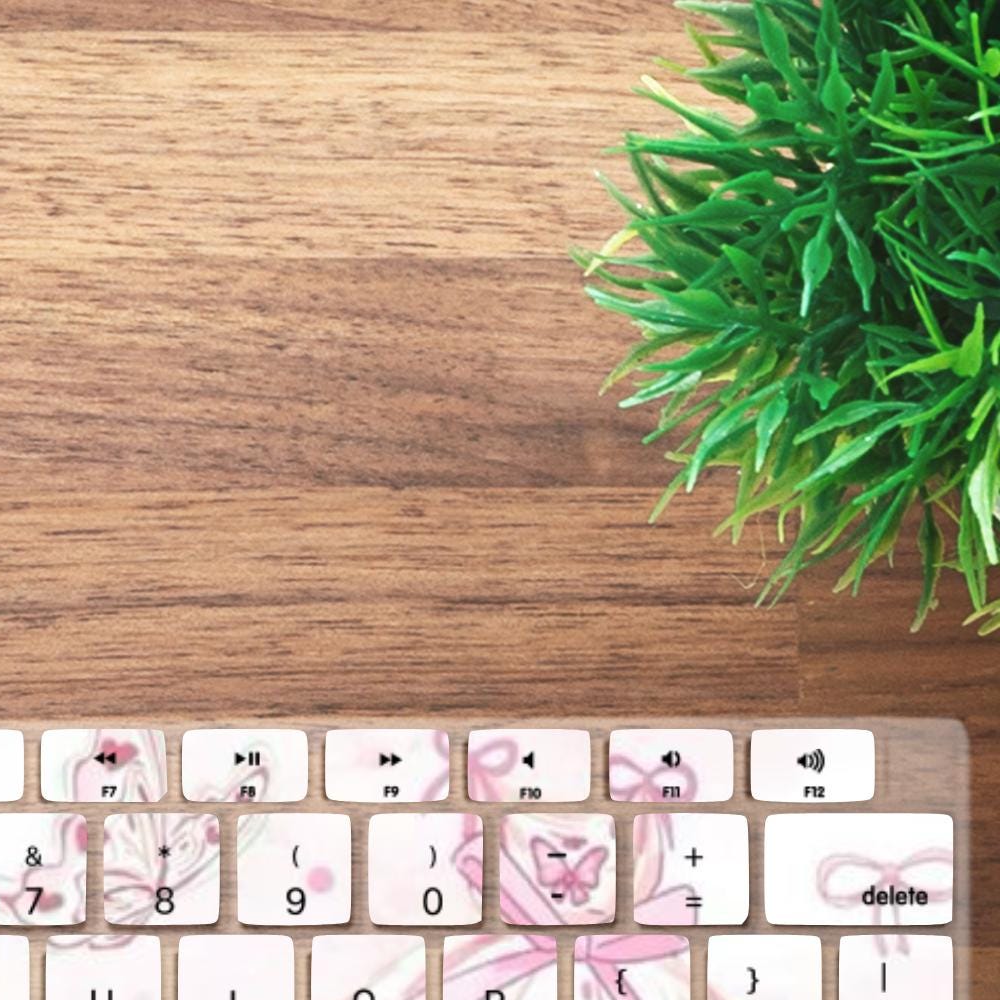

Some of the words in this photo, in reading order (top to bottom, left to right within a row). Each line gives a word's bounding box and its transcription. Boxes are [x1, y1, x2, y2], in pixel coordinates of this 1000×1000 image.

[102, 786, 117, 798] F7
[240, 786, 256, 798] F8
[384, 786, 399, 797] F9
[520, 788, 542, 799] F10
[662, 786, 681, 798] F11
[804, 786, 825, 798] F12
[25, 846, 42, 867] &
[25, 887, 44, 915] 7
[154, 886, 175, 915] 8
[286, 887, 306, 915] 9
[862, 885, 929, 905] delete
